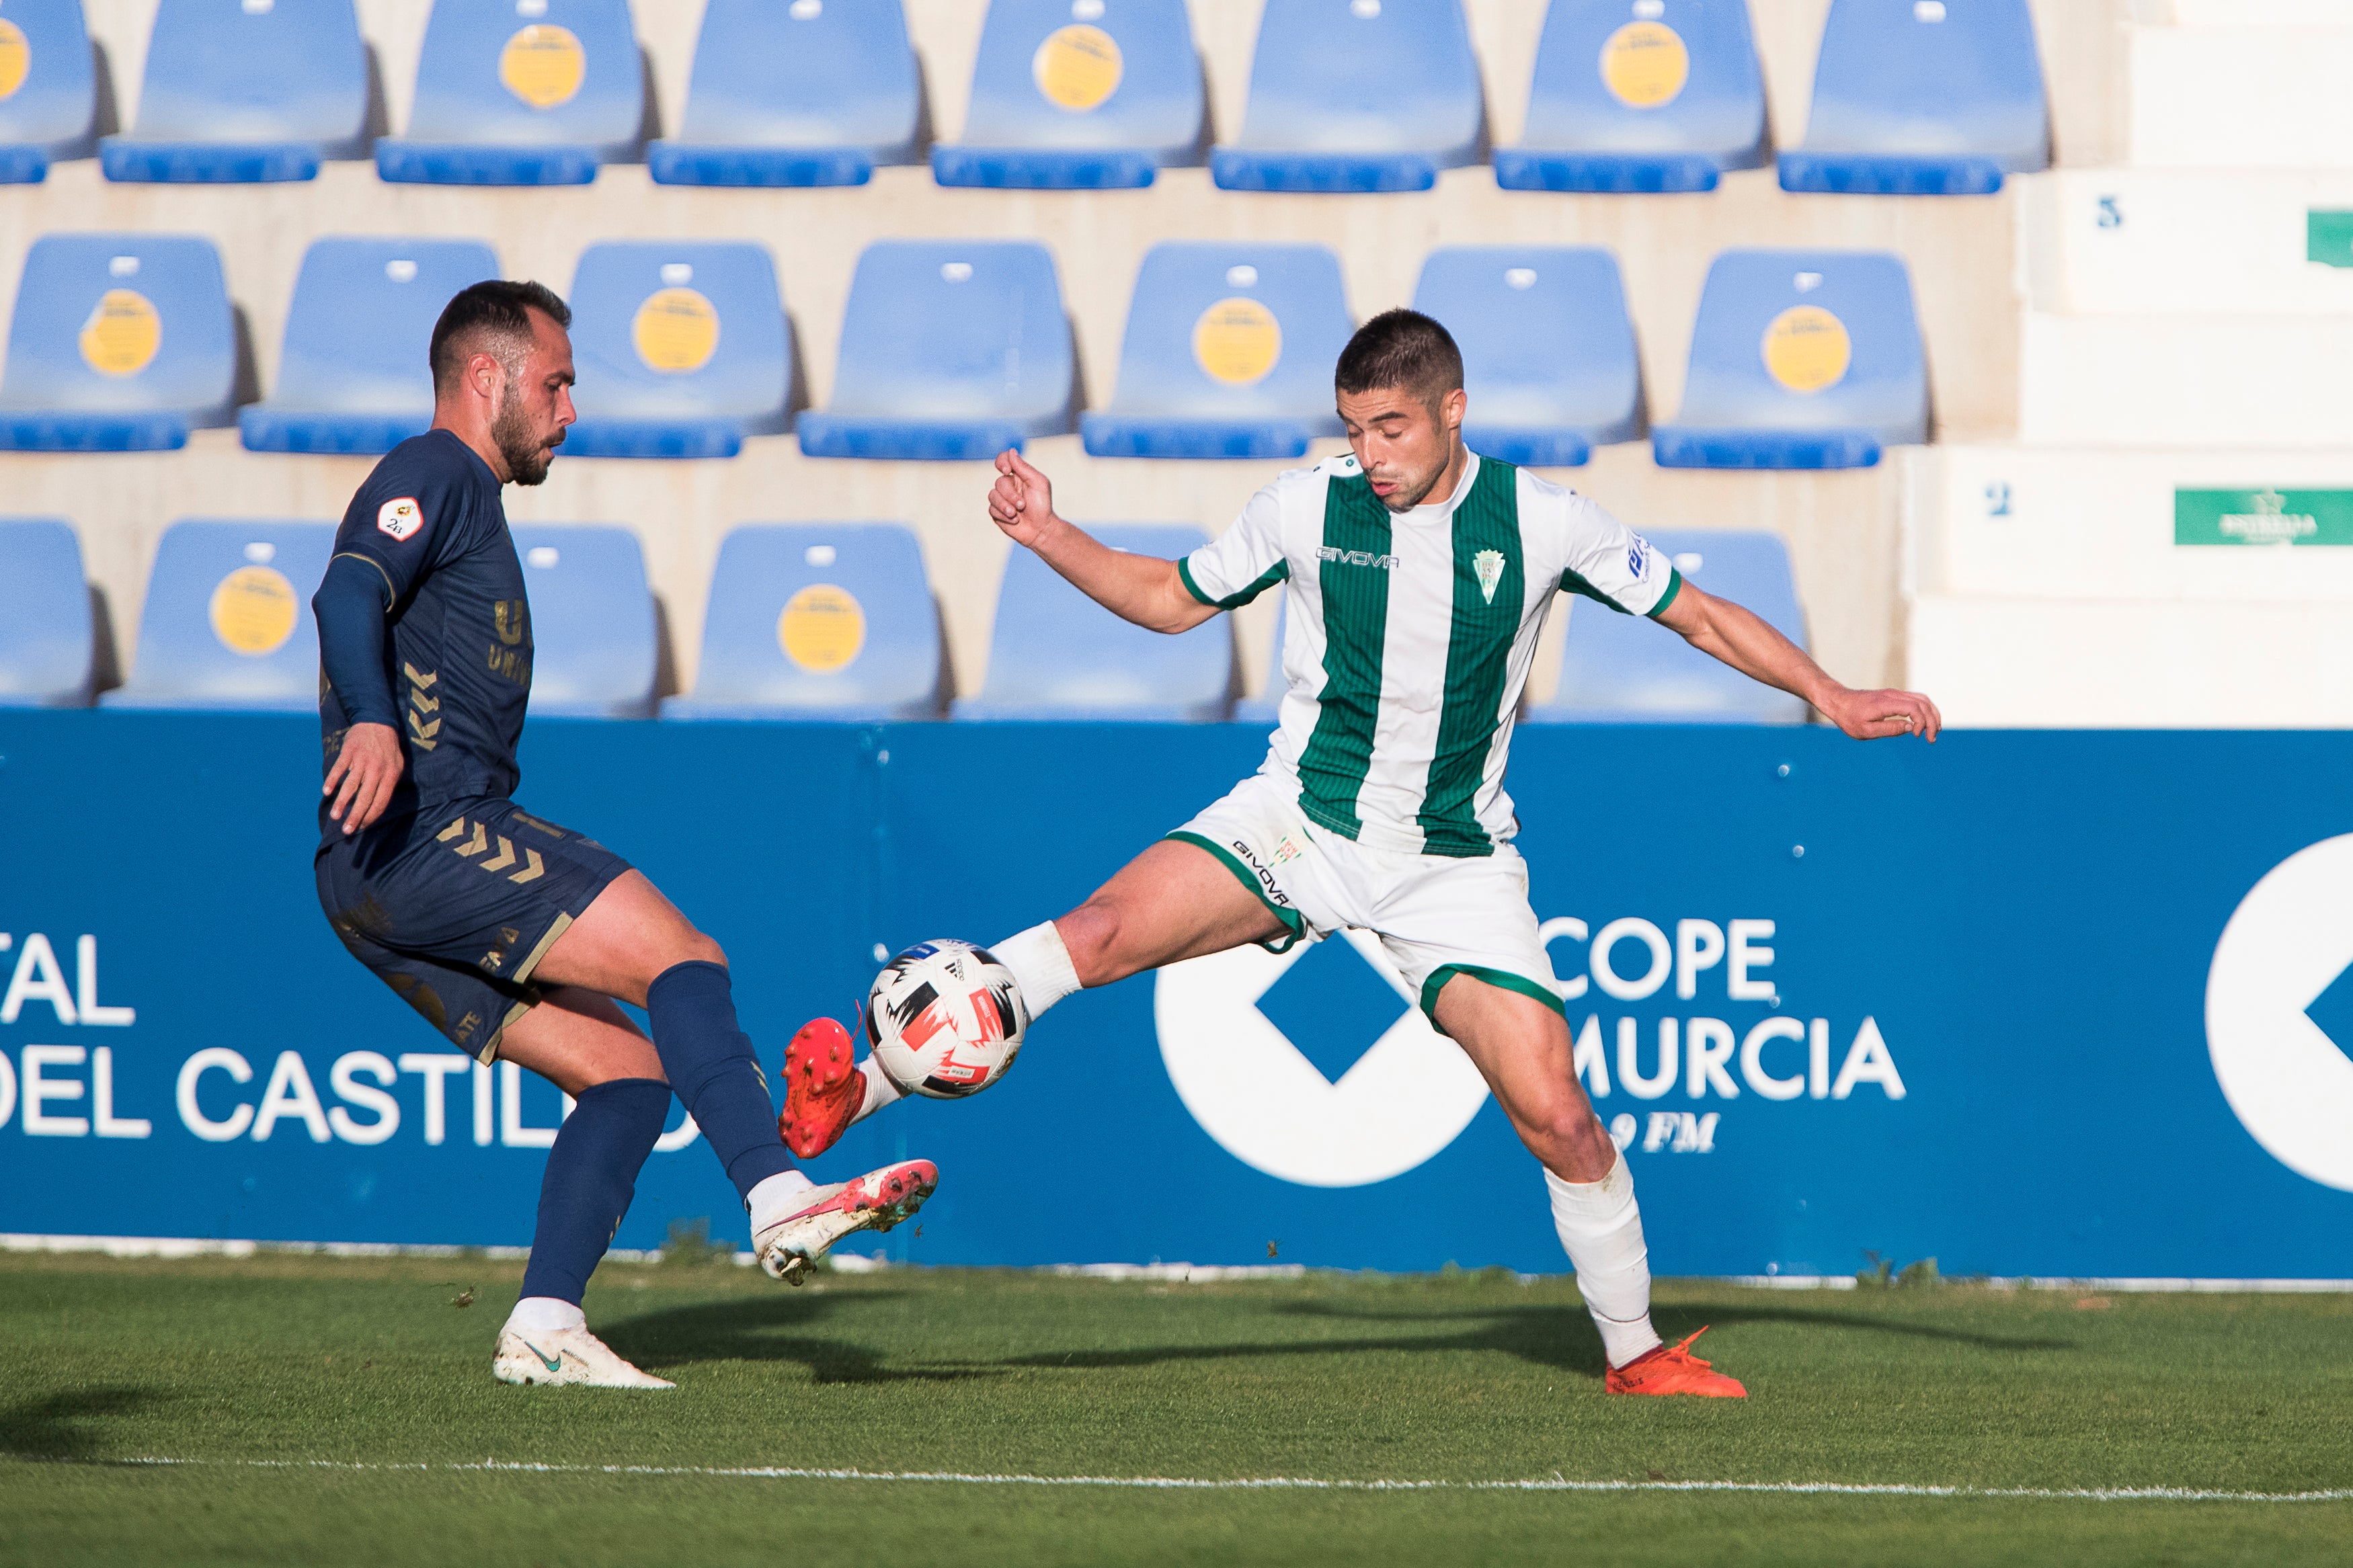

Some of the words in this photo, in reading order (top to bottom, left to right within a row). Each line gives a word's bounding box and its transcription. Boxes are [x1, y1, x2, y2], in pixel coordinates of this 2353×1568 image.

[1316, 546, 1400, 569] GIVOVA
[1233, 840, 1289, 906] GIVOVA
[0, 932, 136, 1027] AL
[1539, 916, 1776, 1001] COPE
[0, 1044, 152, 1139] EL
[176, 1046, 701, 1152] CASTIL
[1642, 1112, 1721, 1153] FM
